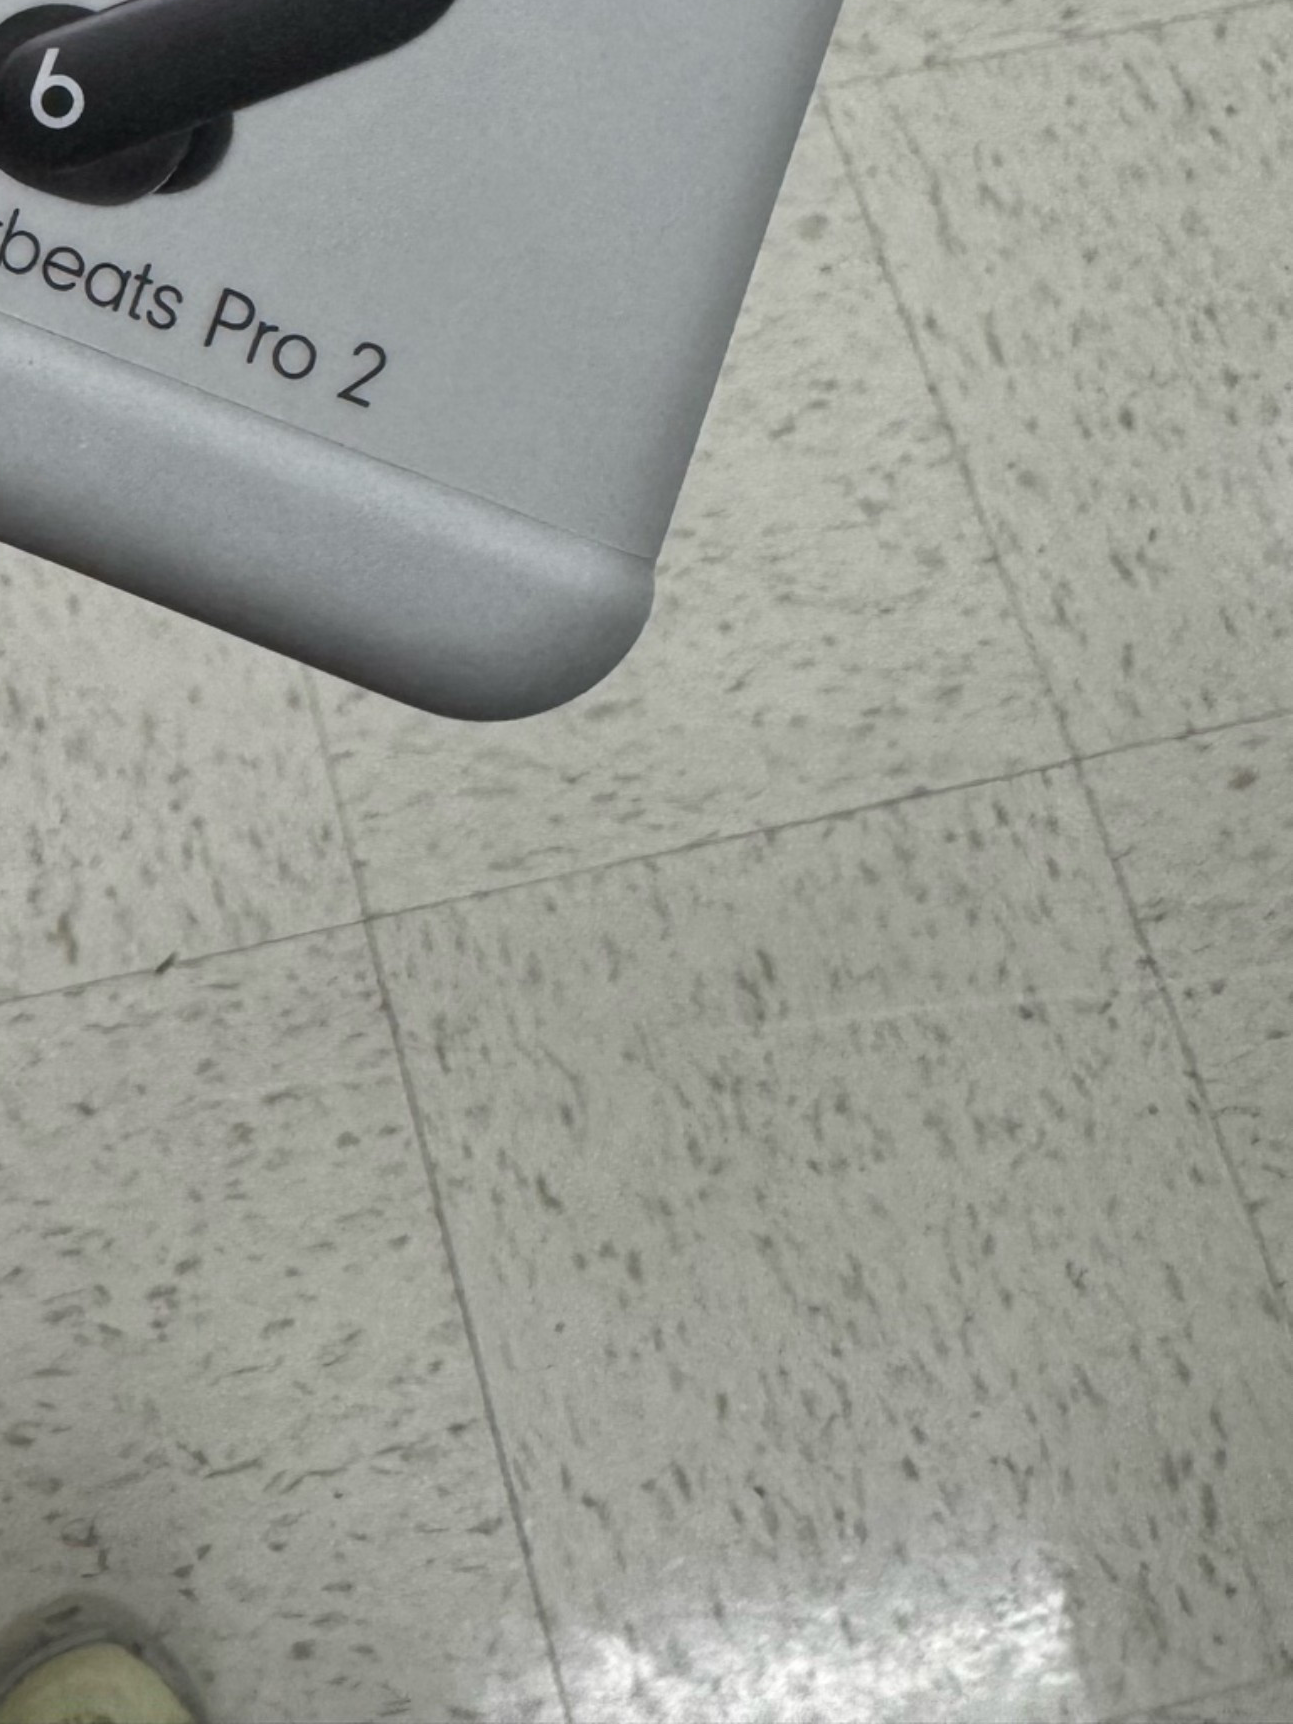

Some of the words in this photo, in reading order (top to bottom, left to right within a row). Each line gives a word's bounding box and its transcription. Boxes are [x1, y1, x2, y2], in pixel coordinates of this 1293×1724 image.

[29, 47, 86, 129] b
[202, 286, 319, 382] Pro
[335, 341, 389, 410] 2
